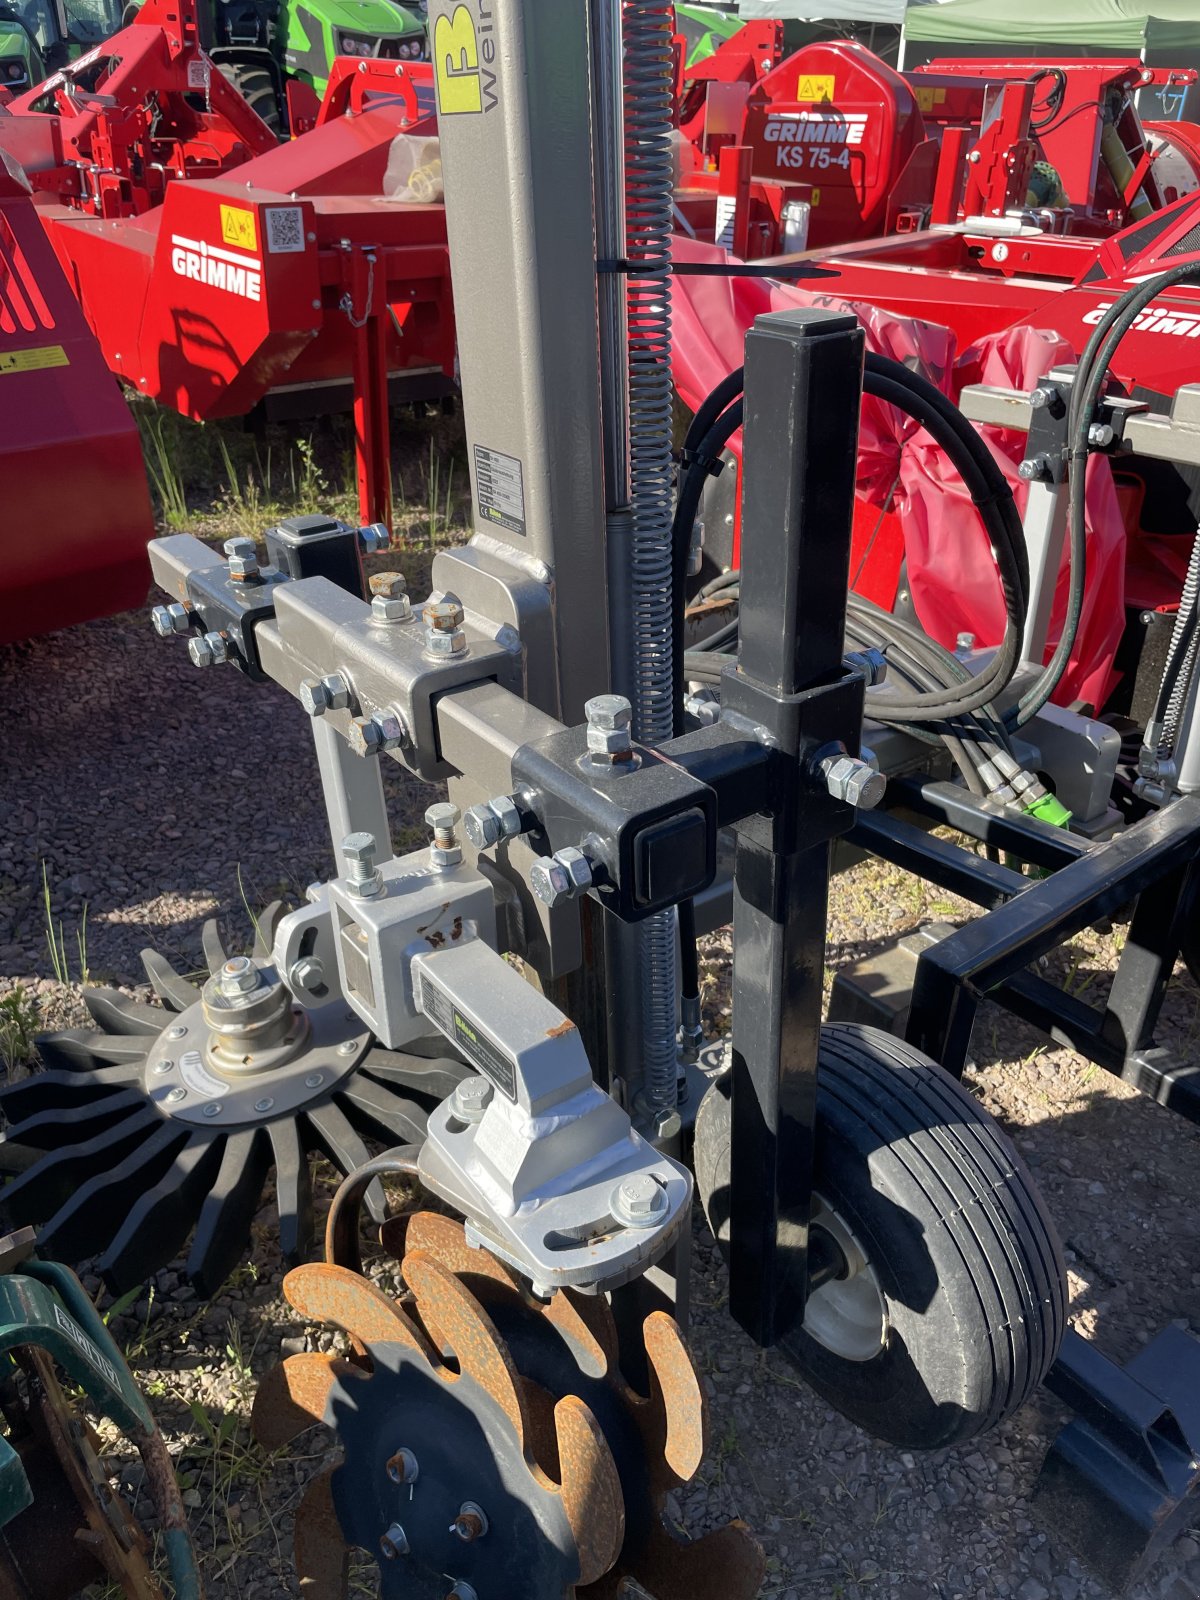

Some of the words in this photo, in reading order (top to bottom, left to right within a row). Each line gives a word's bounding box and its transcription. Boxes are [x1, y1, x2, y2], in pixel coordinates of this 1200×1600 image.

[763, 111, 866, 144] GRIMME
[776, 145, 803, 168] KS
[808, 147, 850, 170] 75-4
[171, 240, 261, 302] GRIMME
